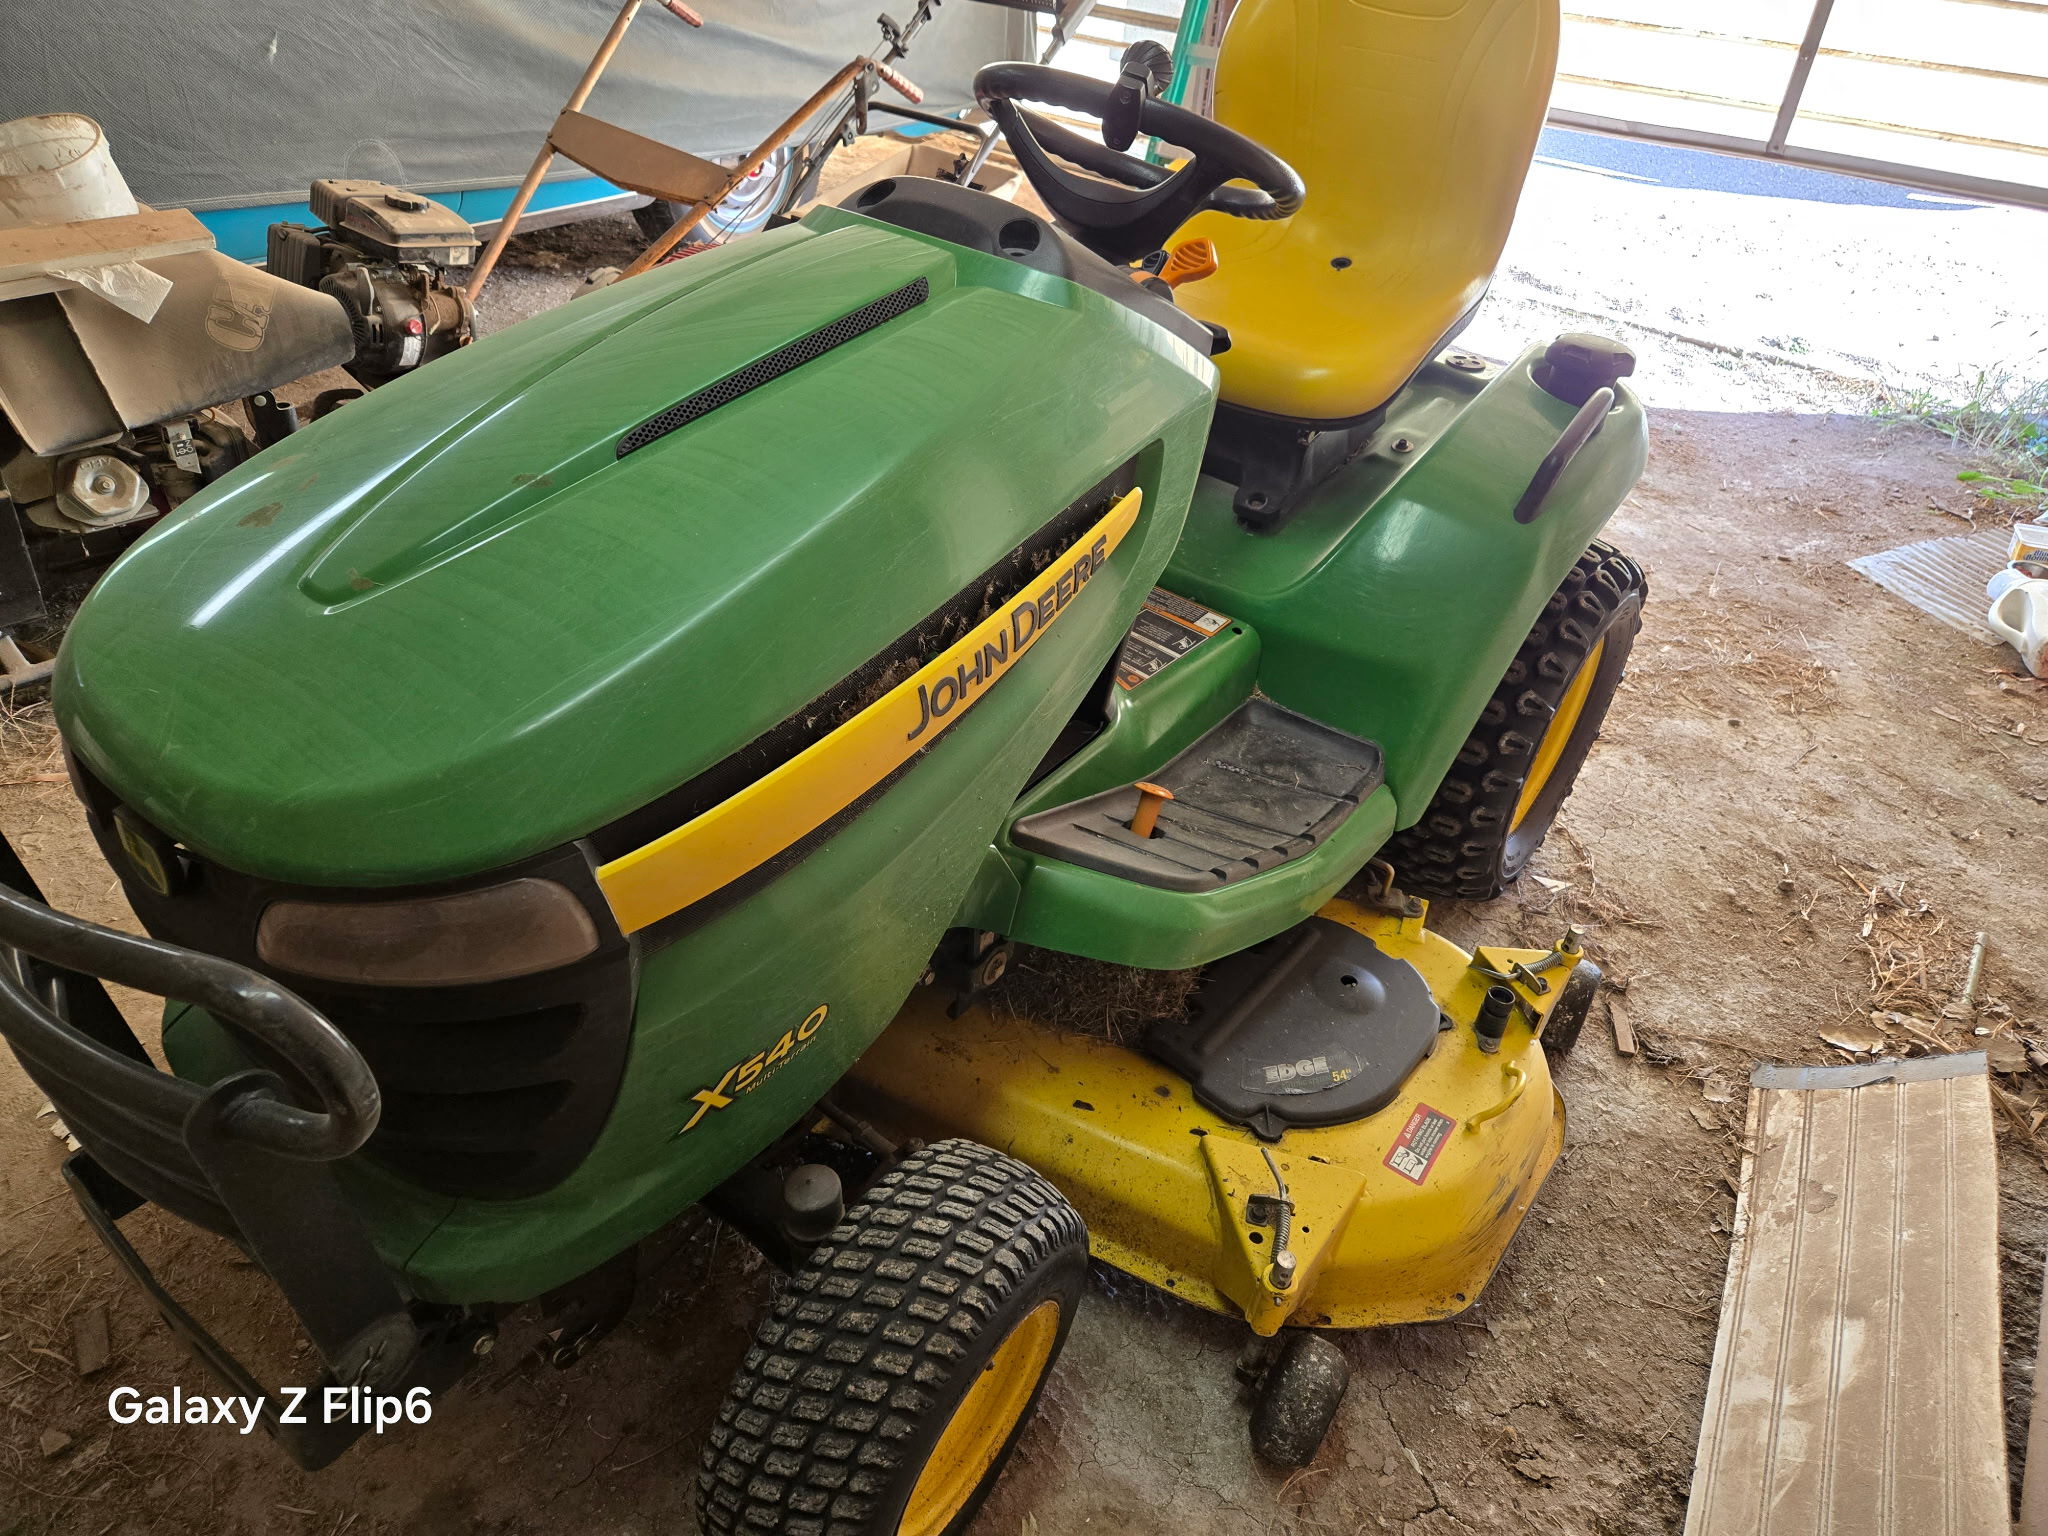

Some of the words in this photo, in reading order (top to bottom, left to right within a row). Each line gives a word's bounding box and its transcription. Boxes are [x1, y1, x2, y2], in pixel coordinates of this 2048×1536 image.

[908, 629, 1008, 741] JOHN
[1011, 534, 1107, 653] DEERE
[678, 1004, 829, 1135] X540
[745, 1036, 816, 1095] Multi-Terrain
[1262, 1056, 1330, 1084] EDGE
[1332, 1068, 1352, 1082] 54"
[1406, 1113, 1422, 1134] DANGER
